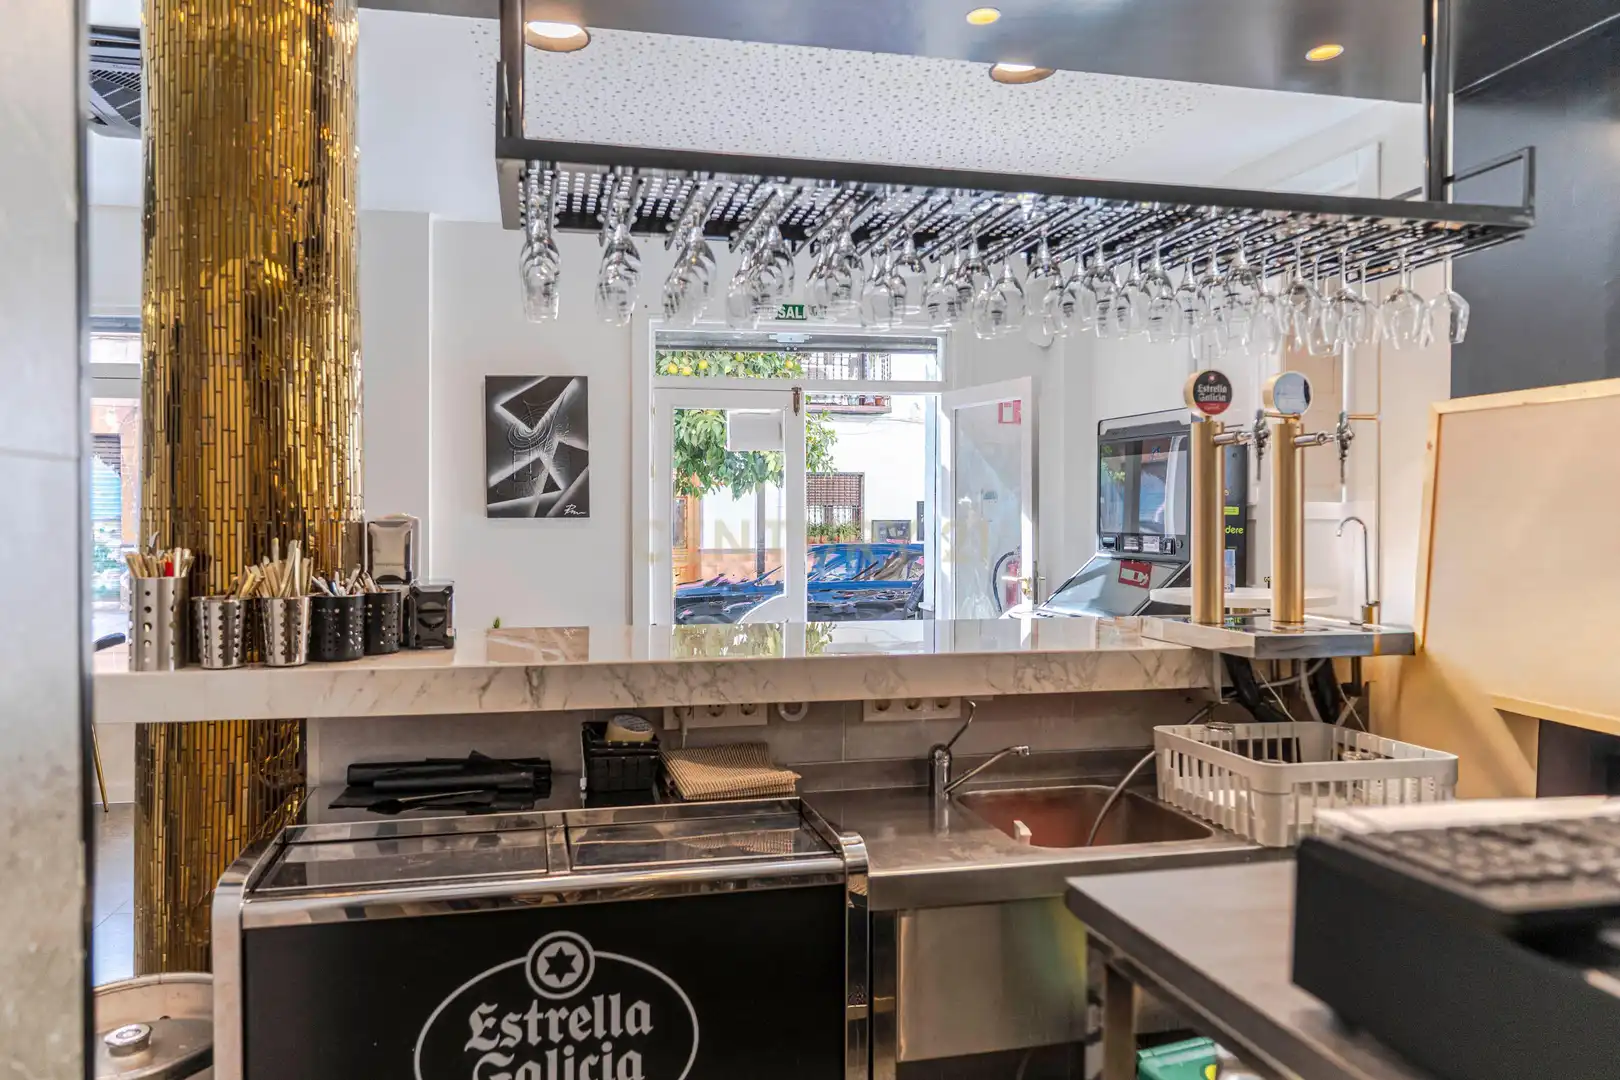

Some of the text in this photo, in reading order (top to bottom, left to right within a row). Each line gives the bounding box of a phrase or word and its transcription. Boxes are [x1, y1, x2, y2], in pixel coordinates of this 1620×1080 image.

[1197, 383, 1228, 393] Estrella
[1198, 393, 1227, 401] Galicia
[464, 992, 653, 1052] Estrella
